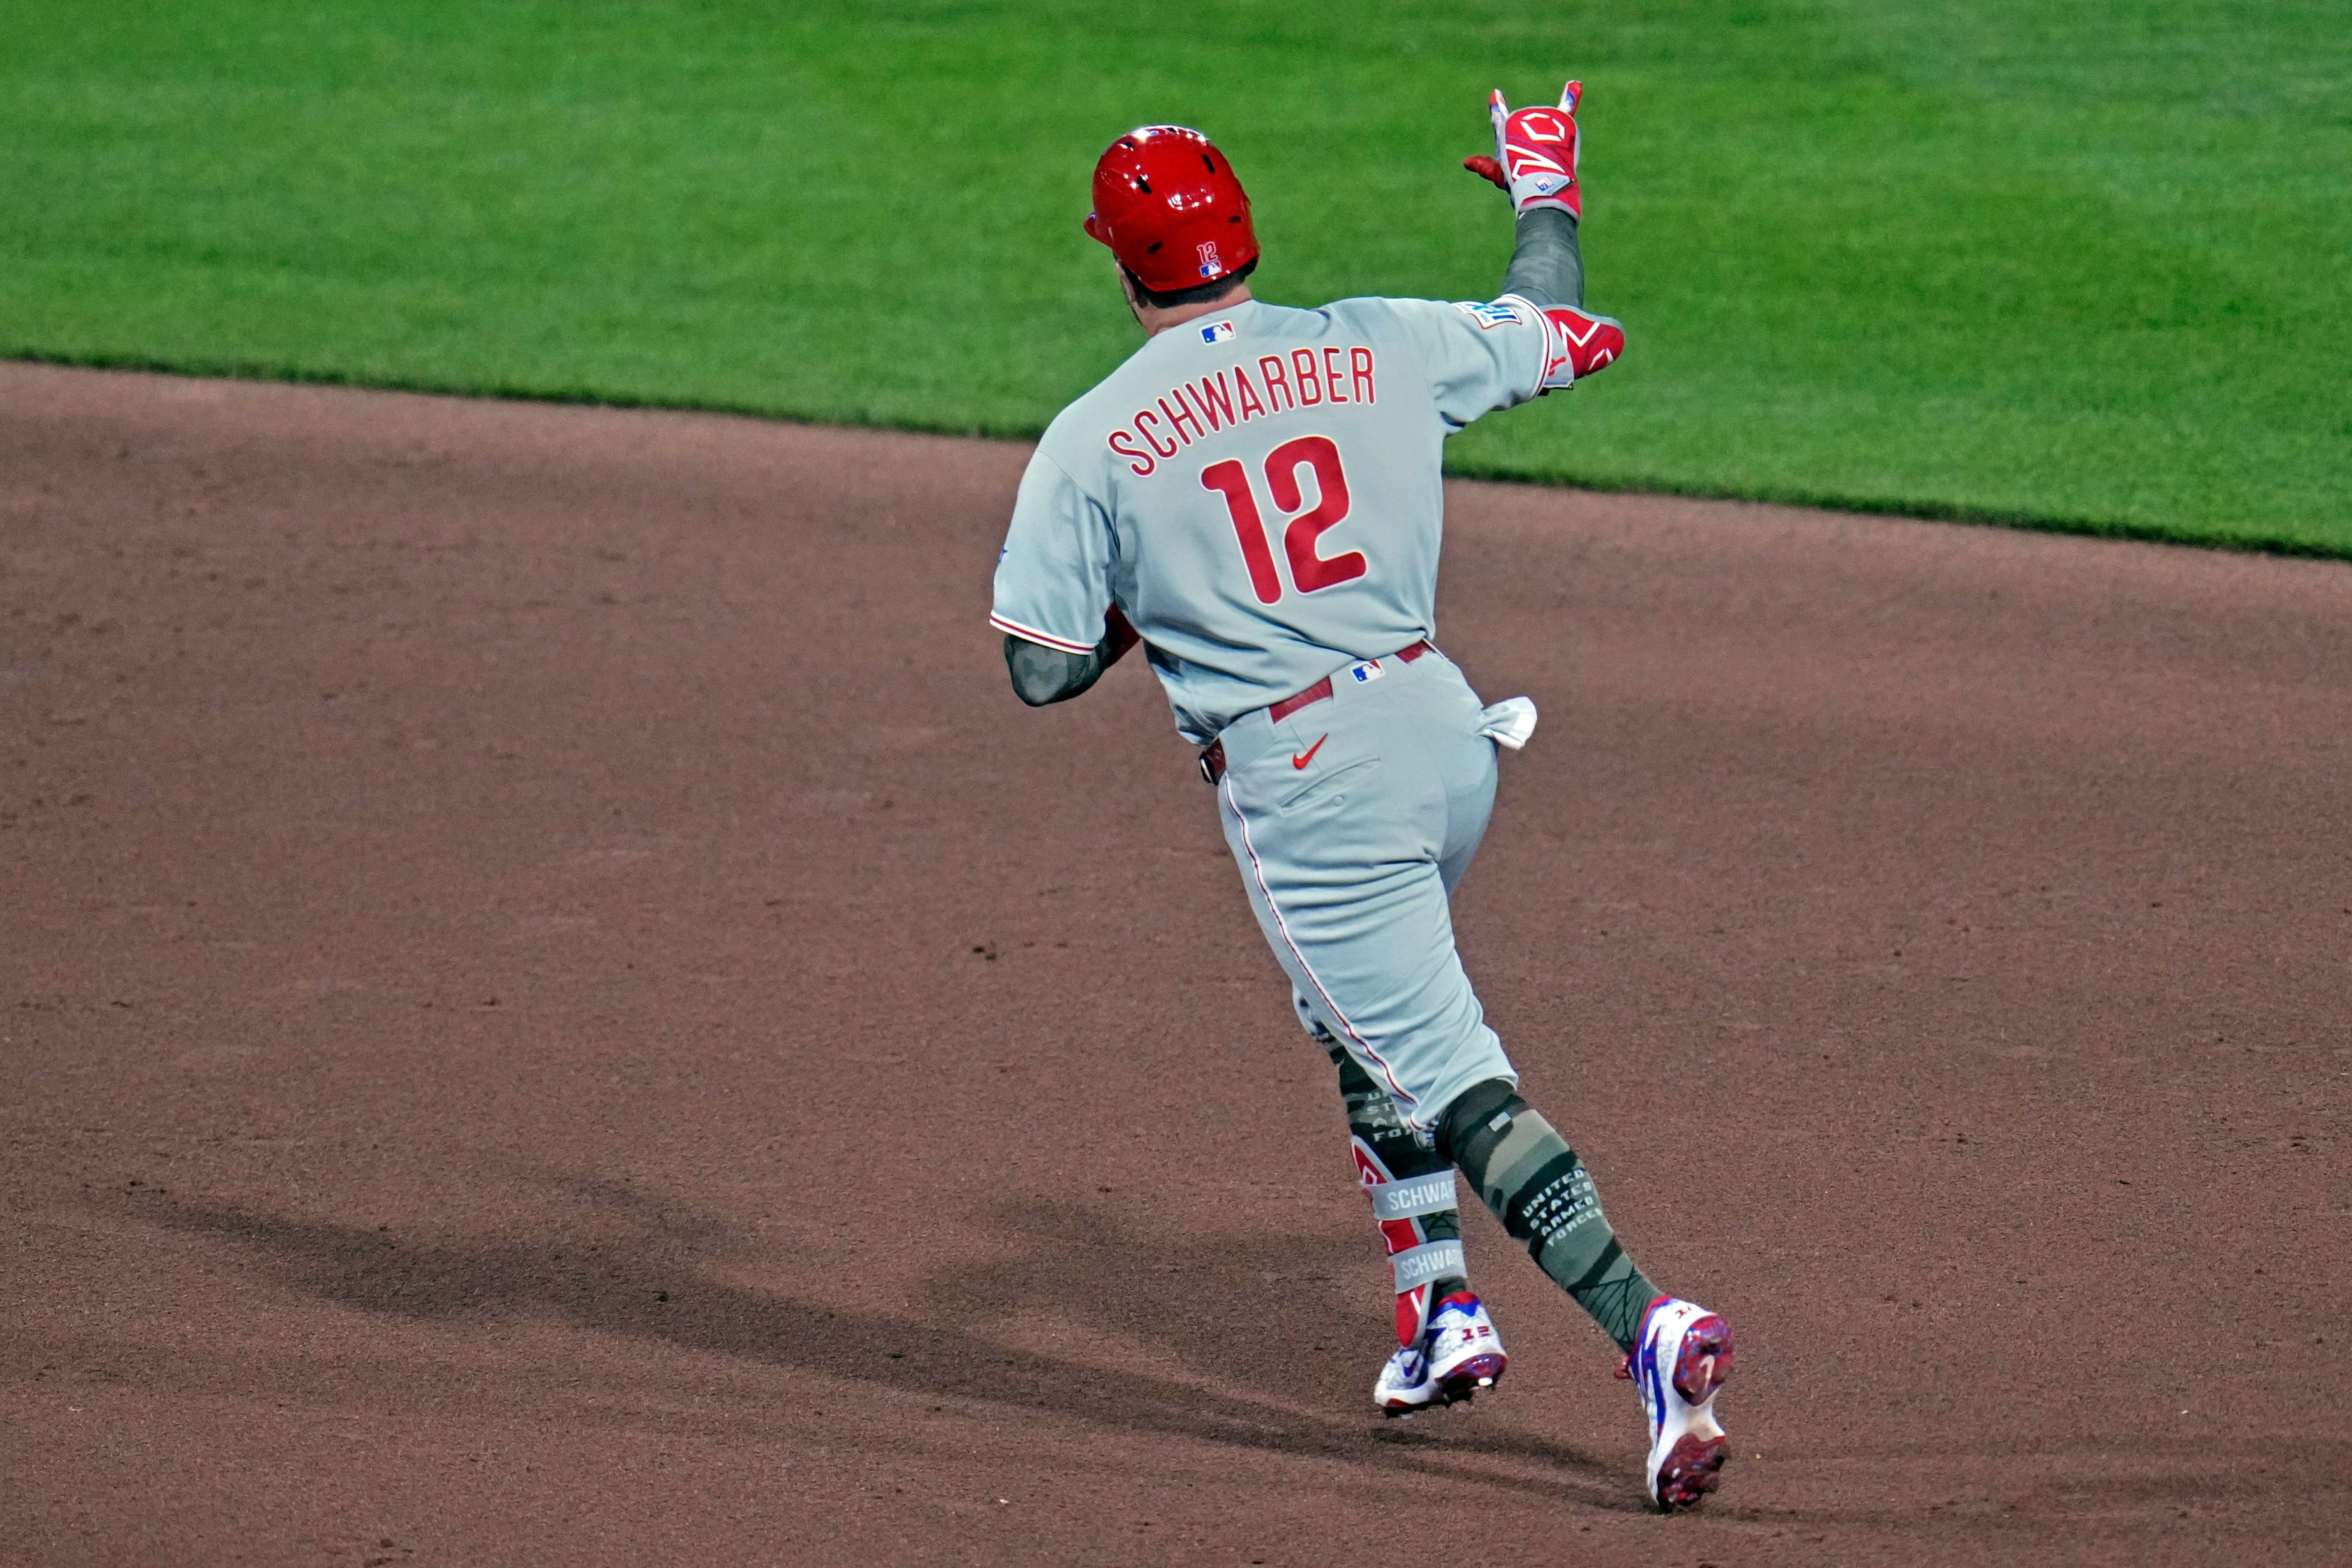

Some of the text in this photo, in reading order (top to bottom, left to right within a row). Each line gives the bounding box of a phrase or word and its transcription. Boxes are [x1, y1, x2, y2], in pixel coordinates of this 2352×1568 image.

[1196, 240, 1219, 264] 12
[1107, 346, 1376, 477] SCHWARBER
[1200, 435, 1367, 605] 12
[1522, 1169, 1584, 1218] UNITED
[1541, 1195, 1593, 1237] ARMED
[1462, 1326, 1491, 1341] 12
